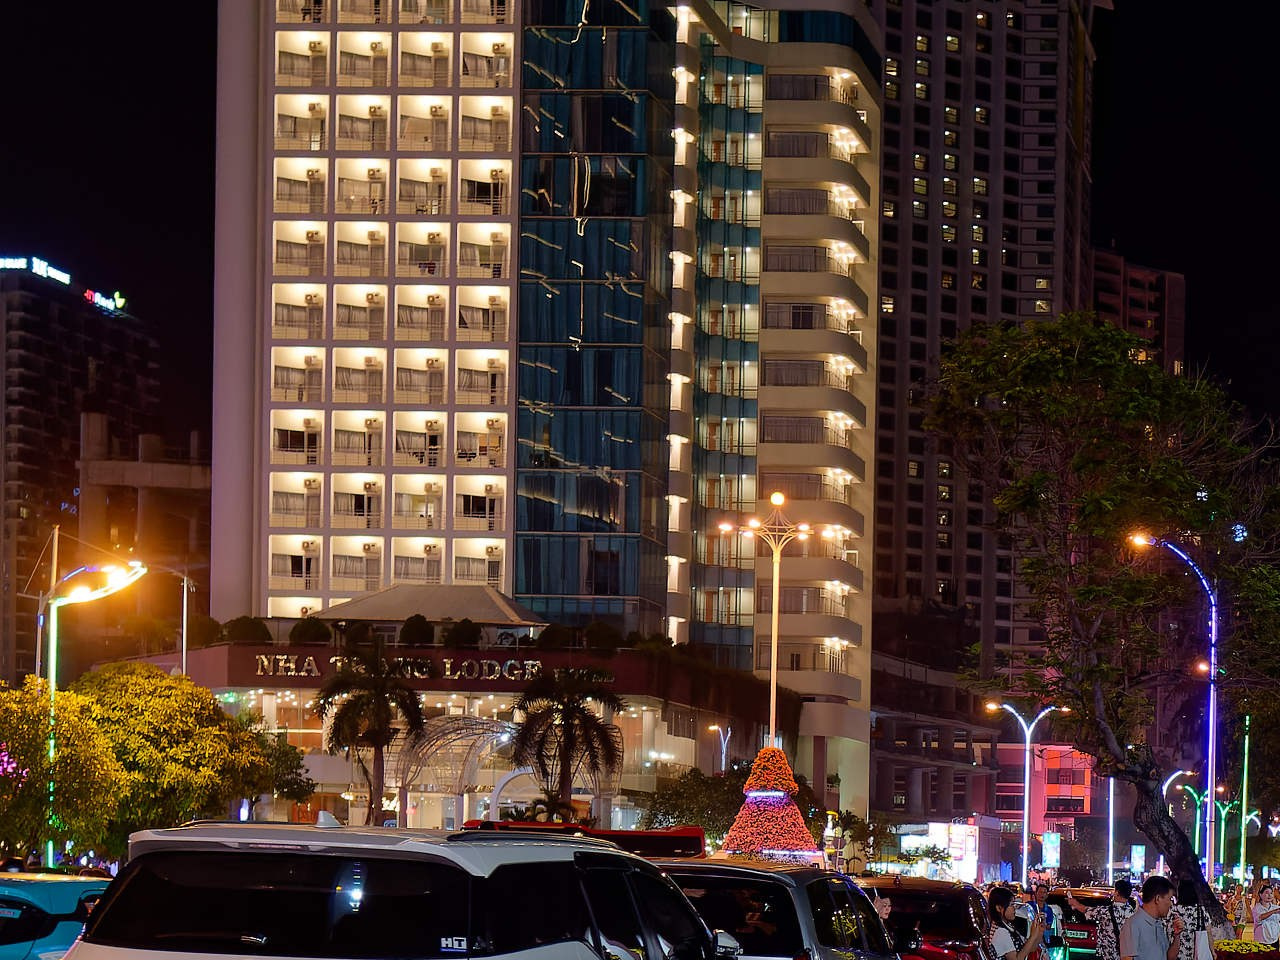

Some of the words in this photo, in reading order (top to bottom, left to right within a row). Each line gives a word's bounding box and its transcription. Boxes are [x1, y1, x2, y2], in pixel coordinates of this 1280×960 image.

[255, 655, 321, 677] NHA
[442, 658, 543, 680] LODGE
[440, 937, 467, 950] HT
